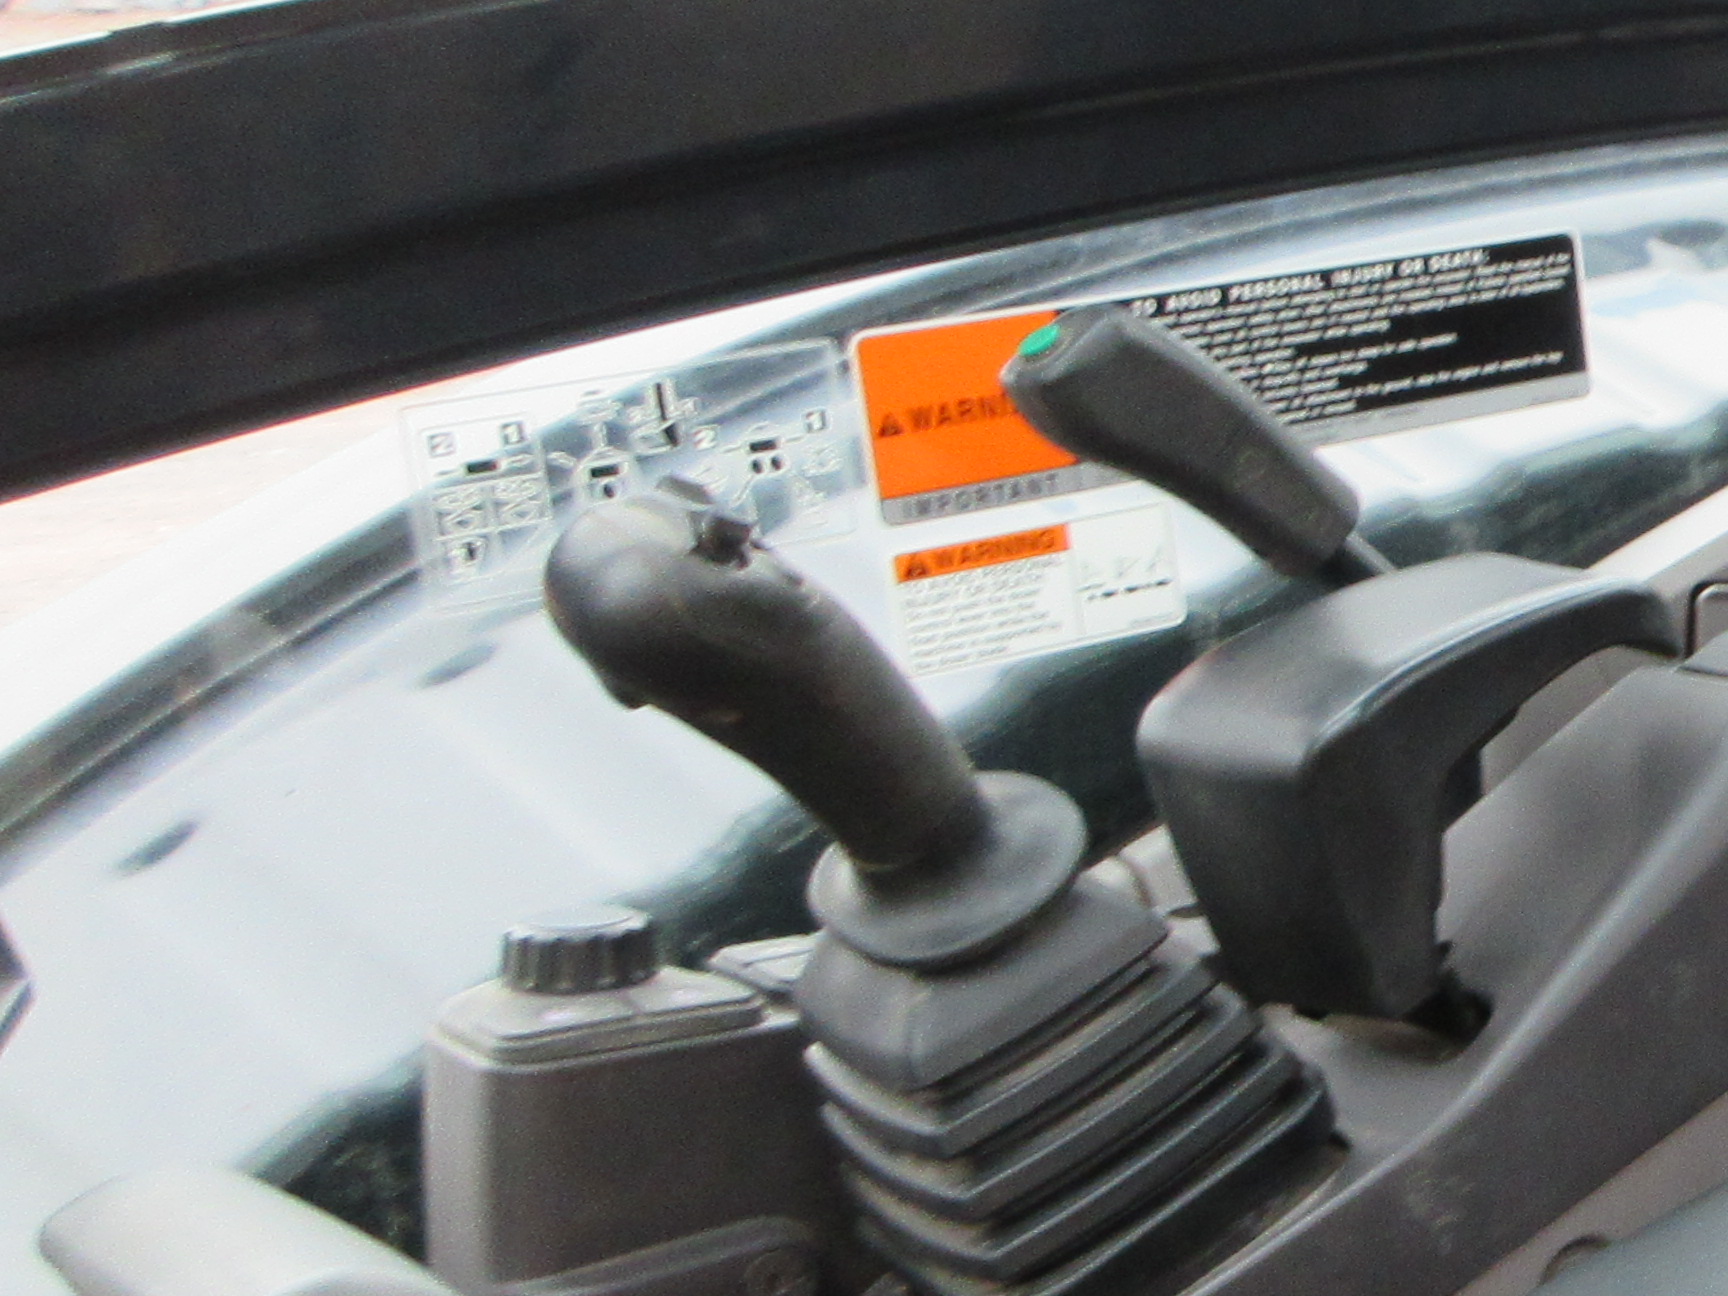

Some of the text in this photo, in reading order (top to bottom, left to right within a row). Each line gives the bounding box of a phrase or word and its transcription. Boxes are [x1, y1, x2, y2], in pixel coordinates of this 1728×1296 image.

[1228, 273, 1324, 303] PERSONAL
[906, 392, 1018, 432] WARNI
[902, 472, 1060, 517] IMPORTANT
[934, 528, 1056, 570] WARNING
